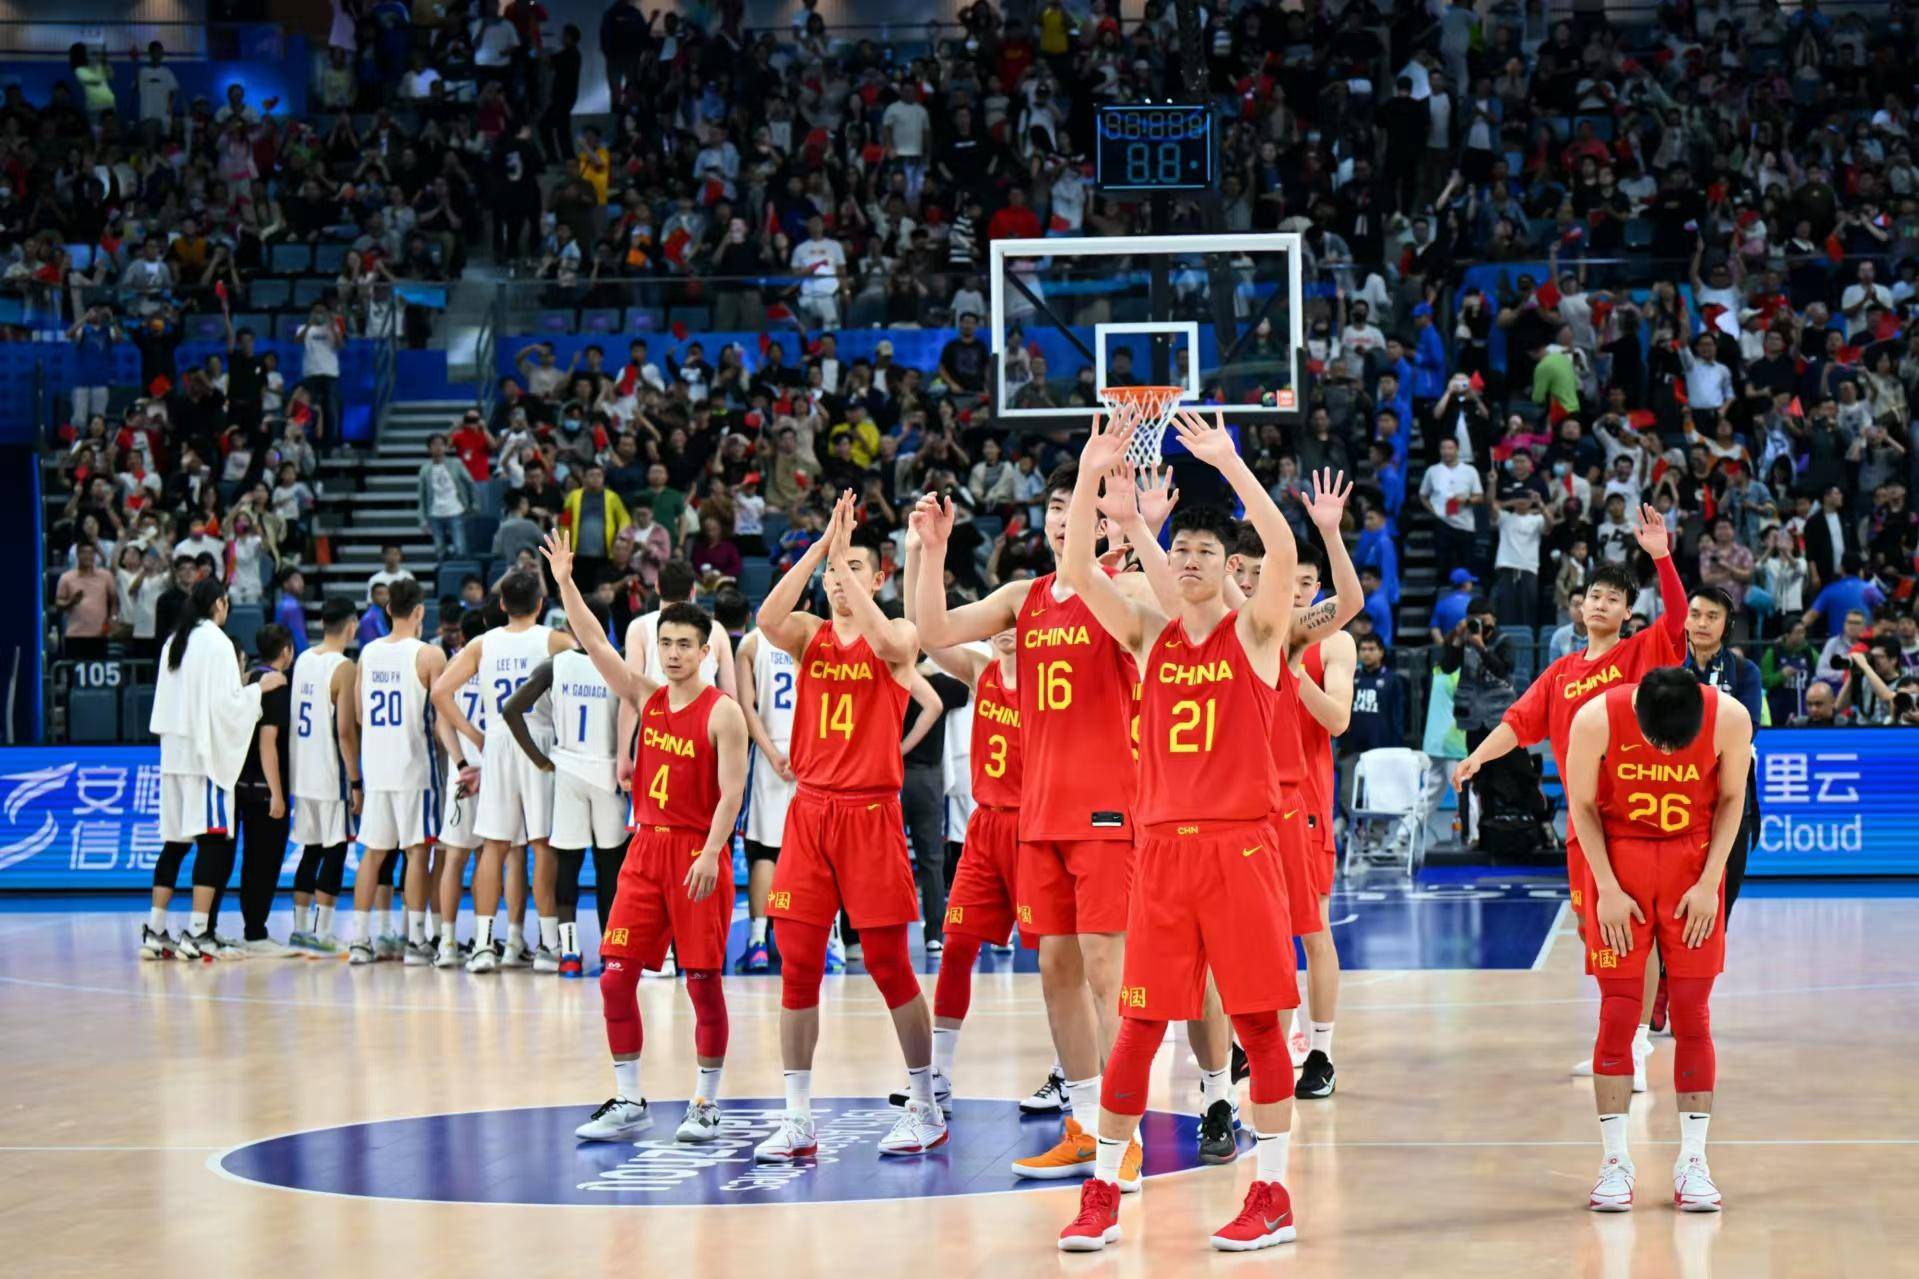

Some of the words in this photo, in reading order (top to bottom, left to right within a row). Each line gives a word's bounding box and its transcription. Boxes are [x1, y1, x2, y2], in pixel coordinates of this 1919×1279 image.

[1024, 625, 1091, 649] CHINA
[75, 663, 121, 686] 105
[496, 659, 511, 671] LEE
[810, 660, 873, 681] CHINA
[1159, 659, 1233, 686] CHINA
[1563, 663, 1623, 699] CHINA
[1037, 660, 1073, 711] 16
[297, 701, 313, 738] 5
[370, 690, 402, 727] 20
[578, 704, 587, 743] 1
[819, 692, 855, 741] 14
[978, 699, 1021, 729] CHIN
[1169, 698, 1217, 753] 21
[643, 727, 696, 759] CHINA
[984, 734, 1008, 778] 3
[648, 763, 670, 809] 4
[1617, 763, 1701, 783] CHINA
[1763, 752, 1861, 803] 里云
[1628, 792, 1692, 832] 26
[1759, 813, 1863, 852] Cloud
